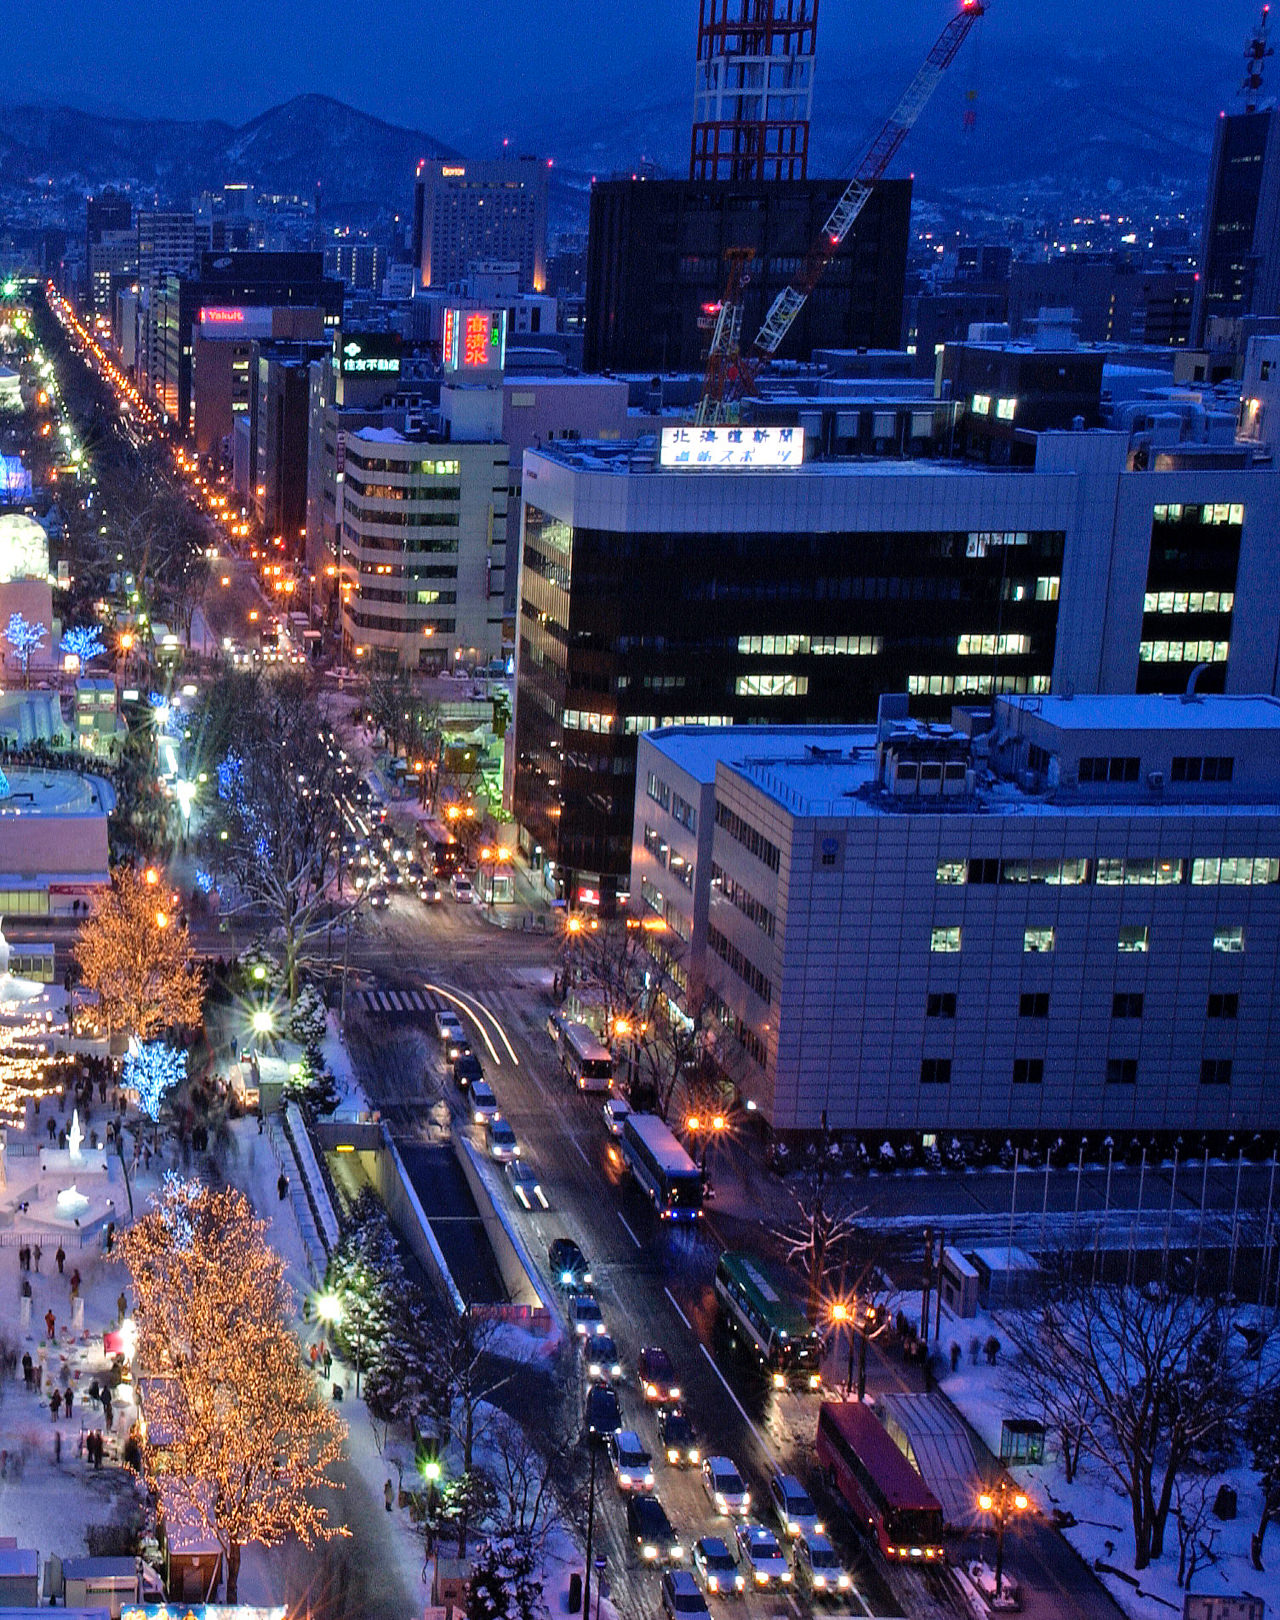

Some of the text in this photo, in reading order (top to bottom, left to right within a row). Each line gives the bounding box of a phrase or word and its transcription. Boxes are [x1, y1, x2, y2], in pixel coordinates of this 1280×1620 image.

[208, 310, 245, 321] Yakult
[344, 359, 400, 371] 住友不動産
[673, 428, 793, 443] 北海道新聞
[674, 448, 791, 462] 道新スポツ
